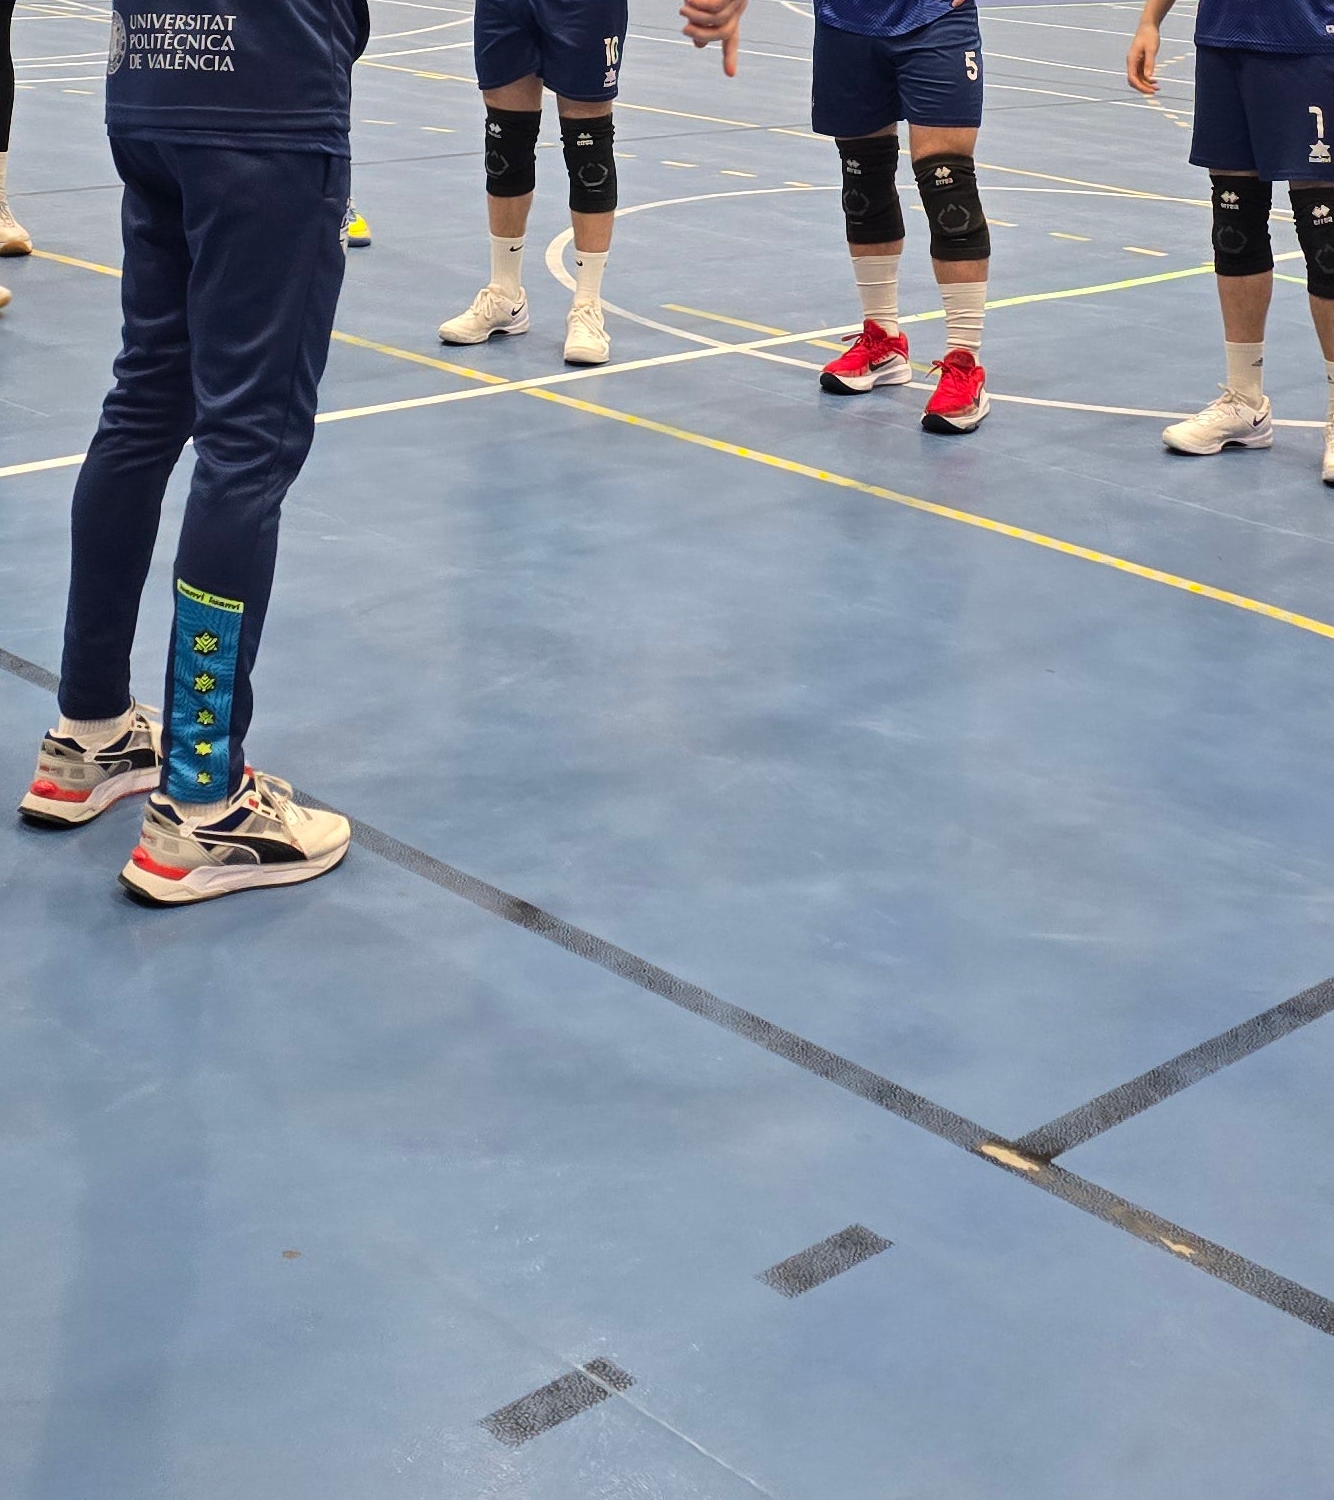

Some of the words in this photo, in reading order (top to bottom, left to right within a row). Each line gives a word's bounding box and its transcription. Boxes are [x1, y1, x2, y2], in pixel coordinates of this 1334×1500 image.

[129, 13, 237, 32] UNIVERSITAT
[129, 30, 236, 52] POLITÈCNICA
[603, 35, 619, 67] 10
[129, 53, 142, 70] DE
[147, 50, 235, 72] VALÈNCIA
[964, 51, 979, 81] 5
[1308, 106, 1324, 139] 1
